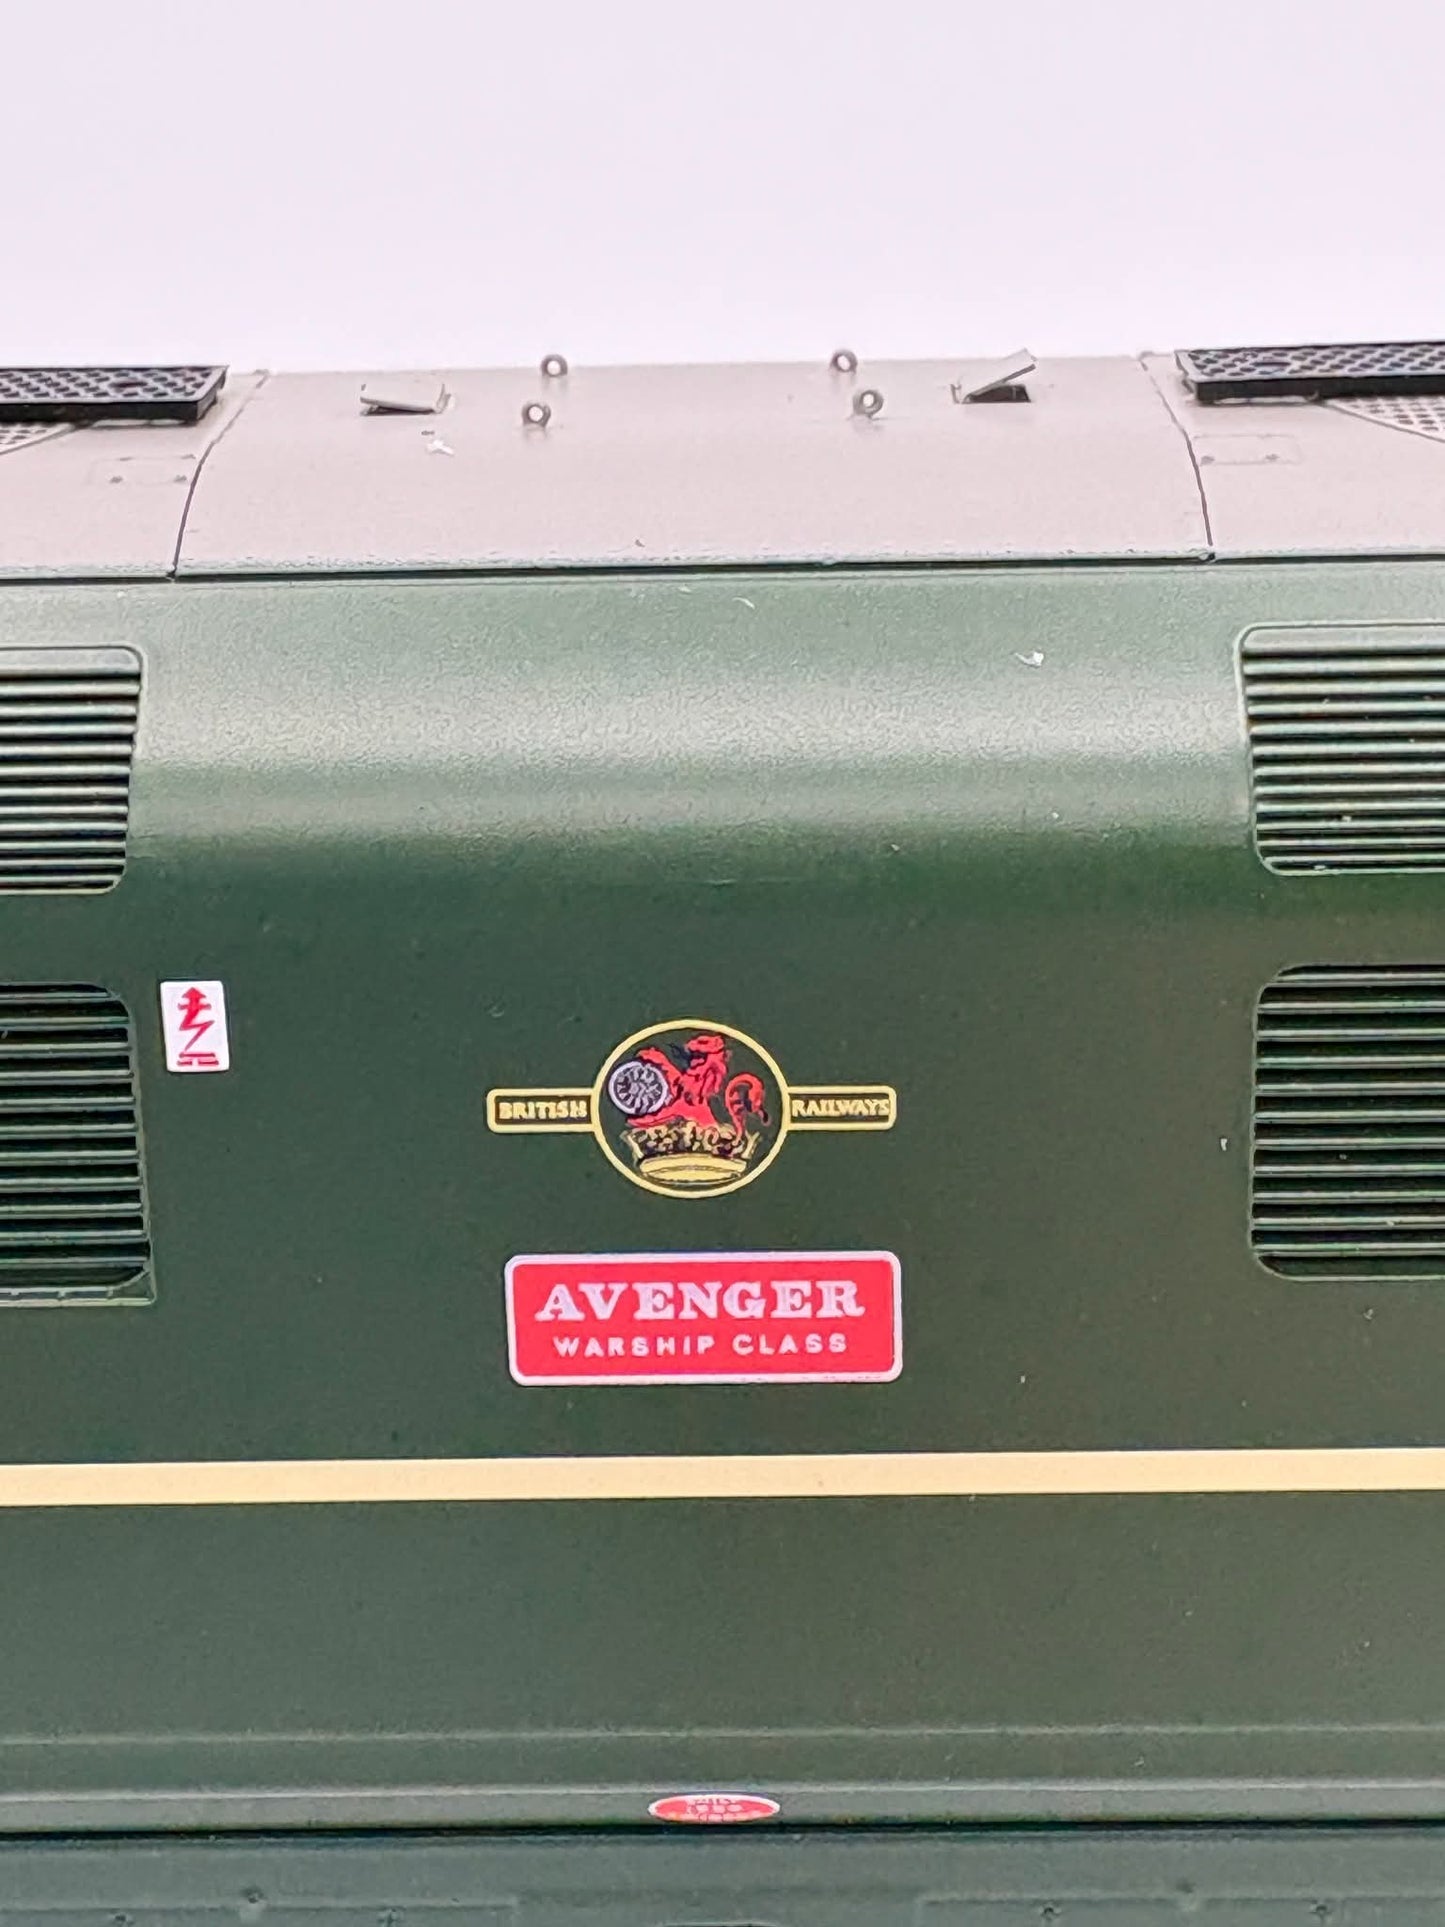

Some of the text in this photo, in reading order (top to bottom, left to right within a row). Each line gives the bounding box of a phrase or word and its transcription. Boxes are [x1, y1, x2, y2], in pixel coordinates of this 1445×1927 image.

[498, 1099, 890, 1119] BRITISH RAILWAYS
[534, 1280, 865, 1322] AVENGER
[553, 1333, 847, 1357] WARSHIP CLASS
